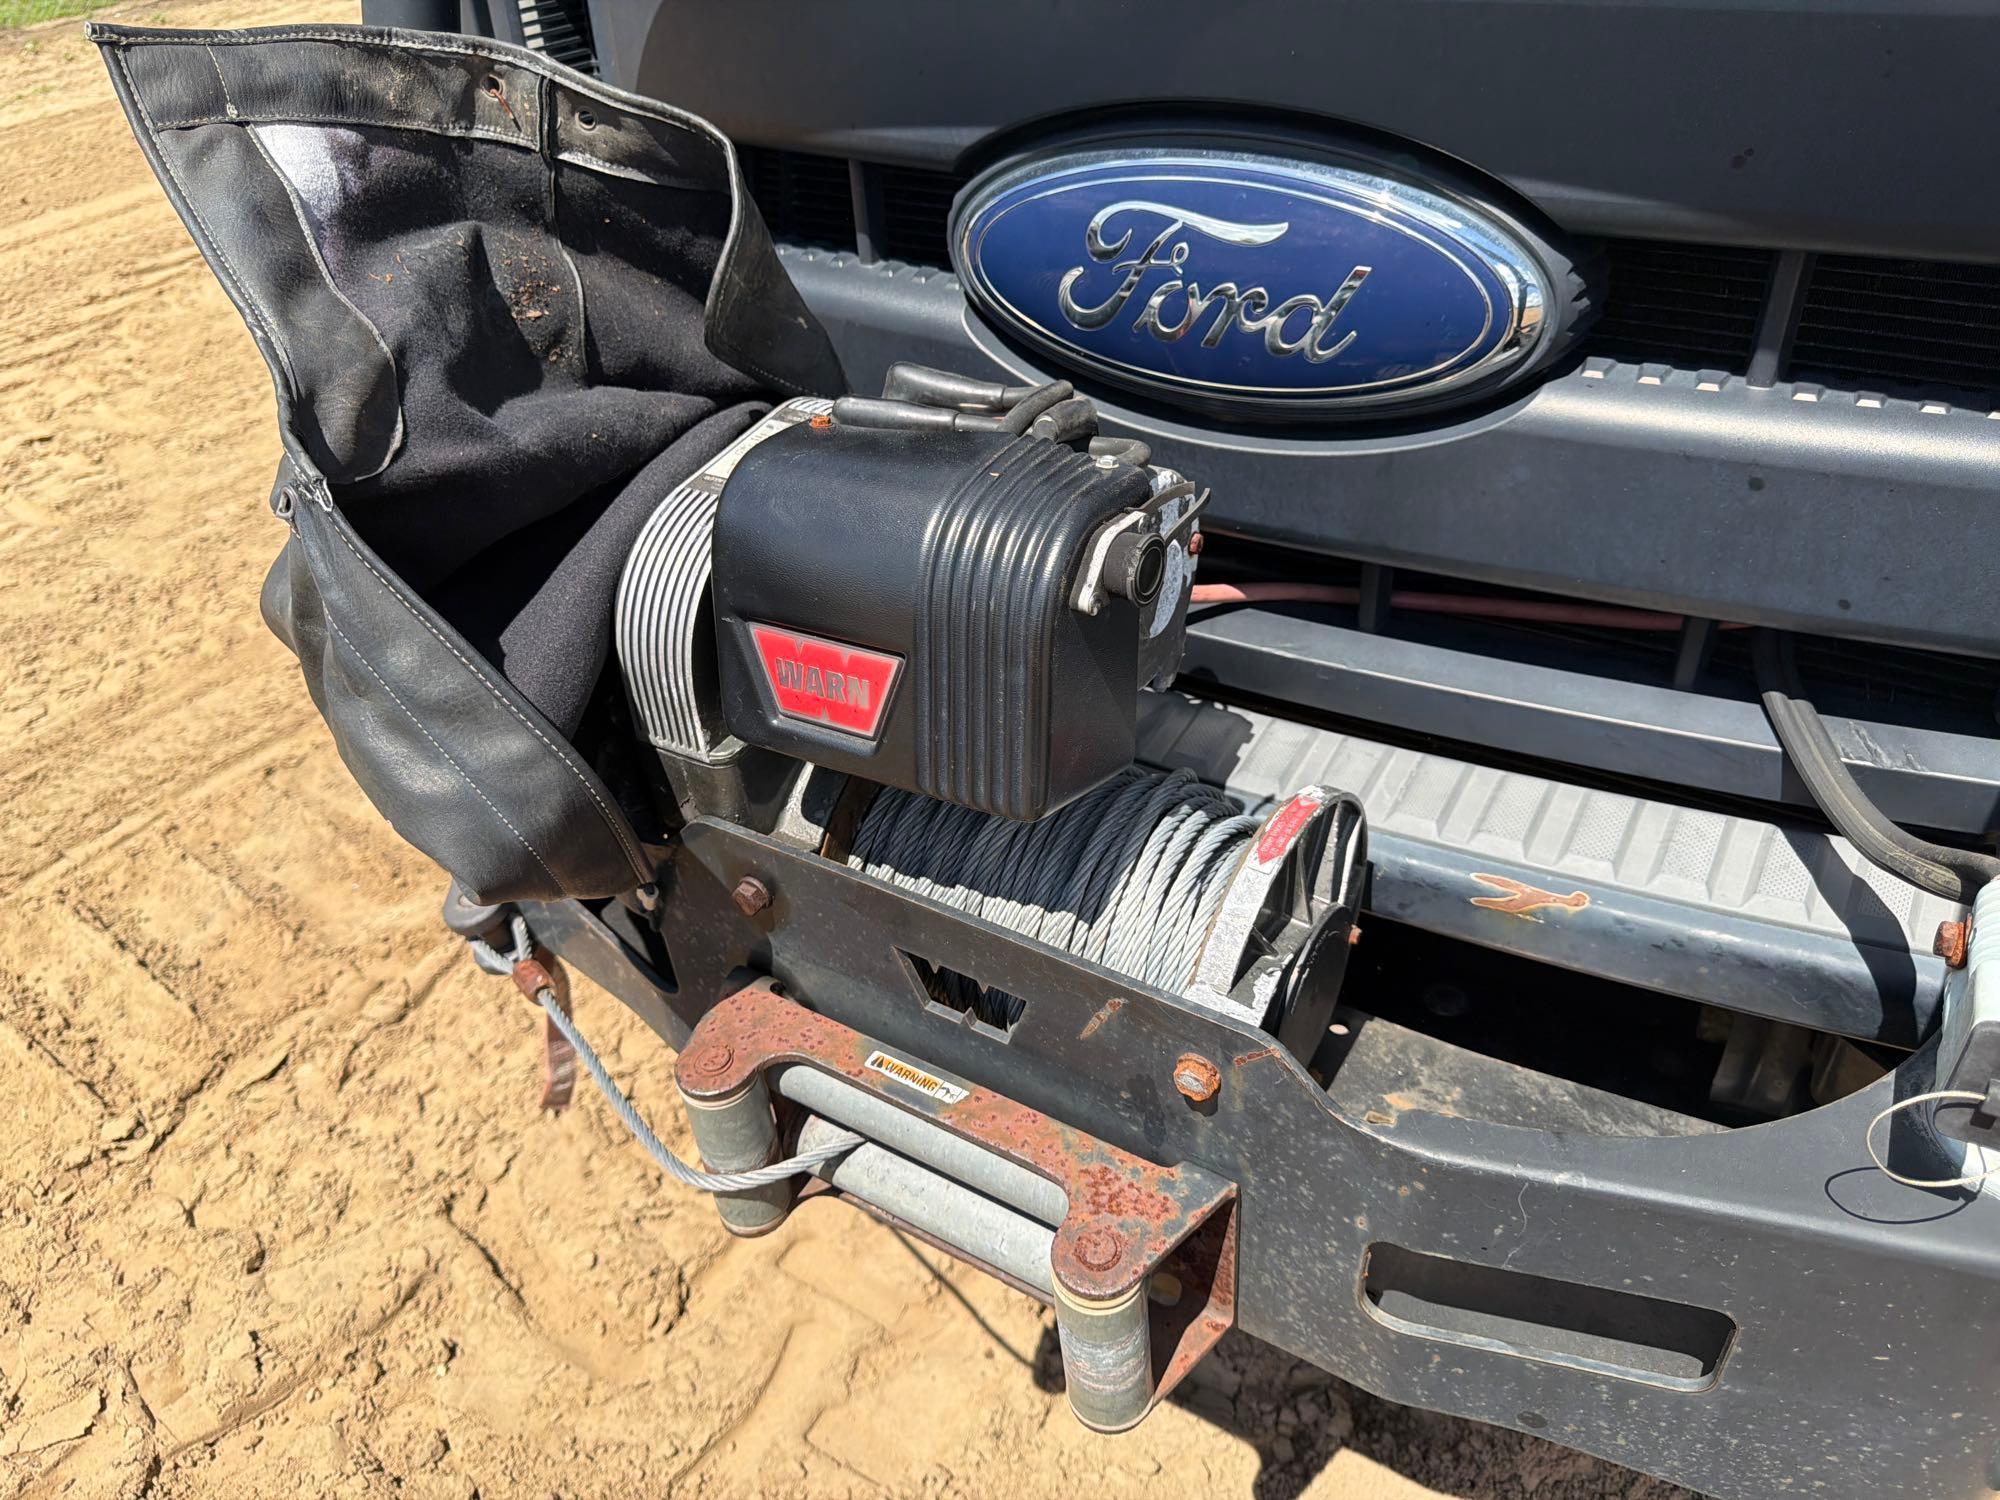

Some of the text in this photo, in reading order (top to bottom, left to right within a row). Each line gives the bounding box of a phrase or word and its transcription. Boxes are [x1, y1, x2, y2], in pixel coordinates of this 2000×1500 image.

[1058, 200, 1372, 364] Ford
[775, 657, 871, 710] WARN
[884, 1062, 938, 1092] WARNING
